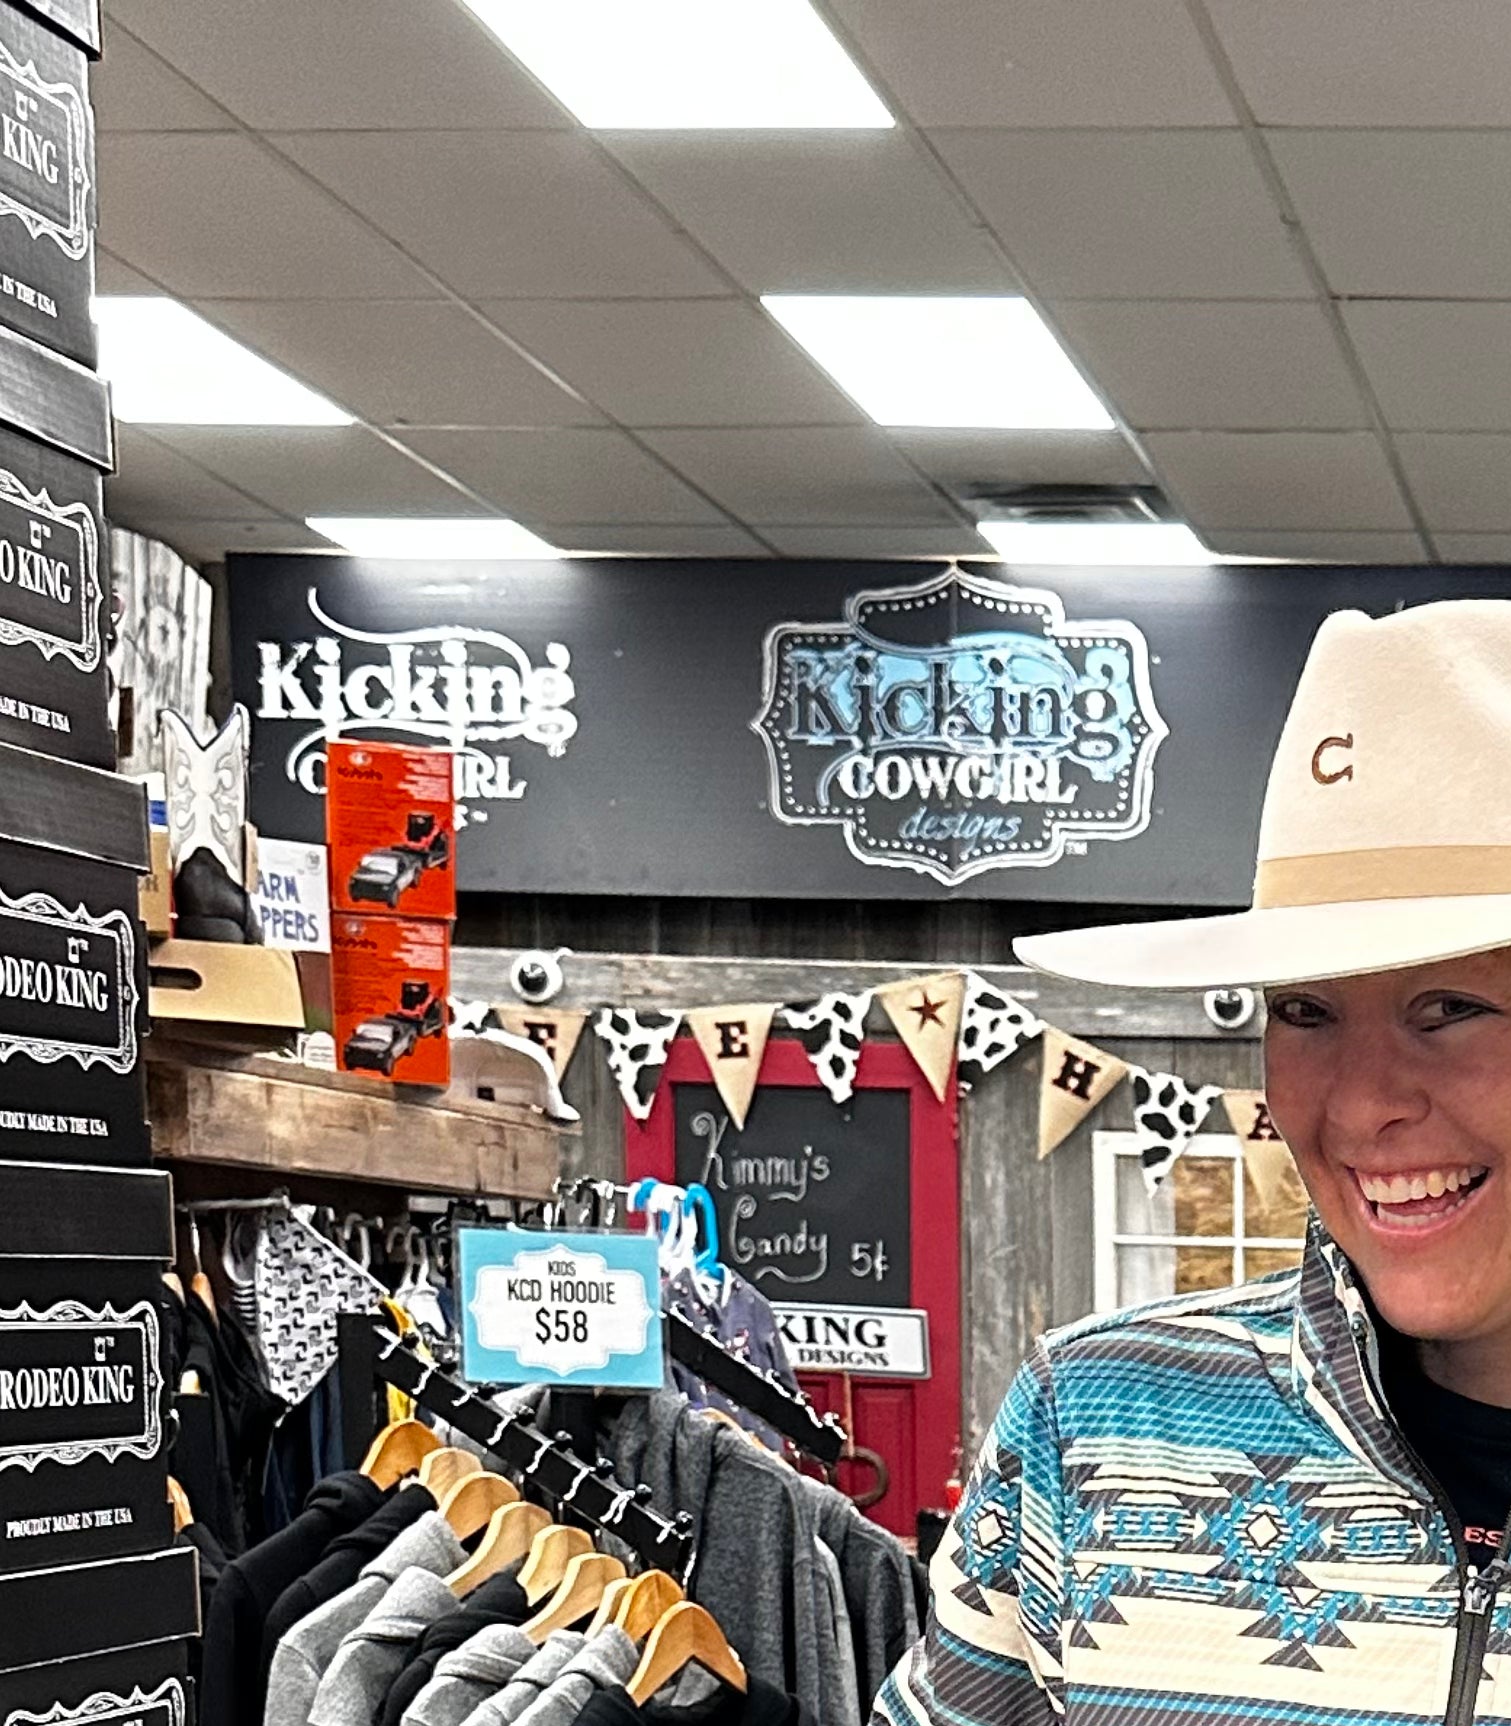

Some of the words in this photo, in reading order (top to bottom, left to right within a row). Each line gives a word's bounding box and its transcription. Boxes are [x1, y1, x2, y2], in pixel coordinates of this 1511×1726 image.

[2, 113, 59, 184] KING
[17, 545, 72, 604] KING
[256, 630, 579, 757] Kicking
[788, 645, 1134, 782] Kicking
[298, 751, 527, 801] CIRL
[837, 755, 1079, 805] COWGIRL
[899, 806, 1022, 850] designs
[257, 869, 301, 904] ARM
[260, 905, 320, 943] PPERS
[0, 956, 53, 1003] ODEO
[55, 963, 109, 1012] KING
[714, 1021, 751, 1060] E
[1052, 1049, 1102, 1101] H
[1247, 1103, 1284, 1141] A
[0, 1110, 27, 1131] UDLY
[27, 1112, 57, 1132] MADE
[69, 1117, 90, 1136] THE
[89, 1119, 109, 1138] USA
[690, 1111, 831, 1202] Kimmy's
[729, 1193, 828, 1284] Candy
[548, 1260, 576, 1277] KIDS
[507, 1278, 542, 1302] KCD
[550, 1280, 617, 1305] HOODIE
[535, 1306, 588, 1345] $58
[774, 1313, 888, 1349] KING
[799, 1348, 890, 1367] DESIGNS
[0, 1367, 80, 1410] RODEO
[82, 1364, 135, 1406] KING
[6, 1516, 52, 1539] PROUDLY
[52, 1513, 82, 1534] MADE
[81, 1511, 94, 1529] IN
[94, 1509, 114, 1528] THE
[114, 1507, 133, 1525] USA
[1464, 1526, 1505, 1548] ES
